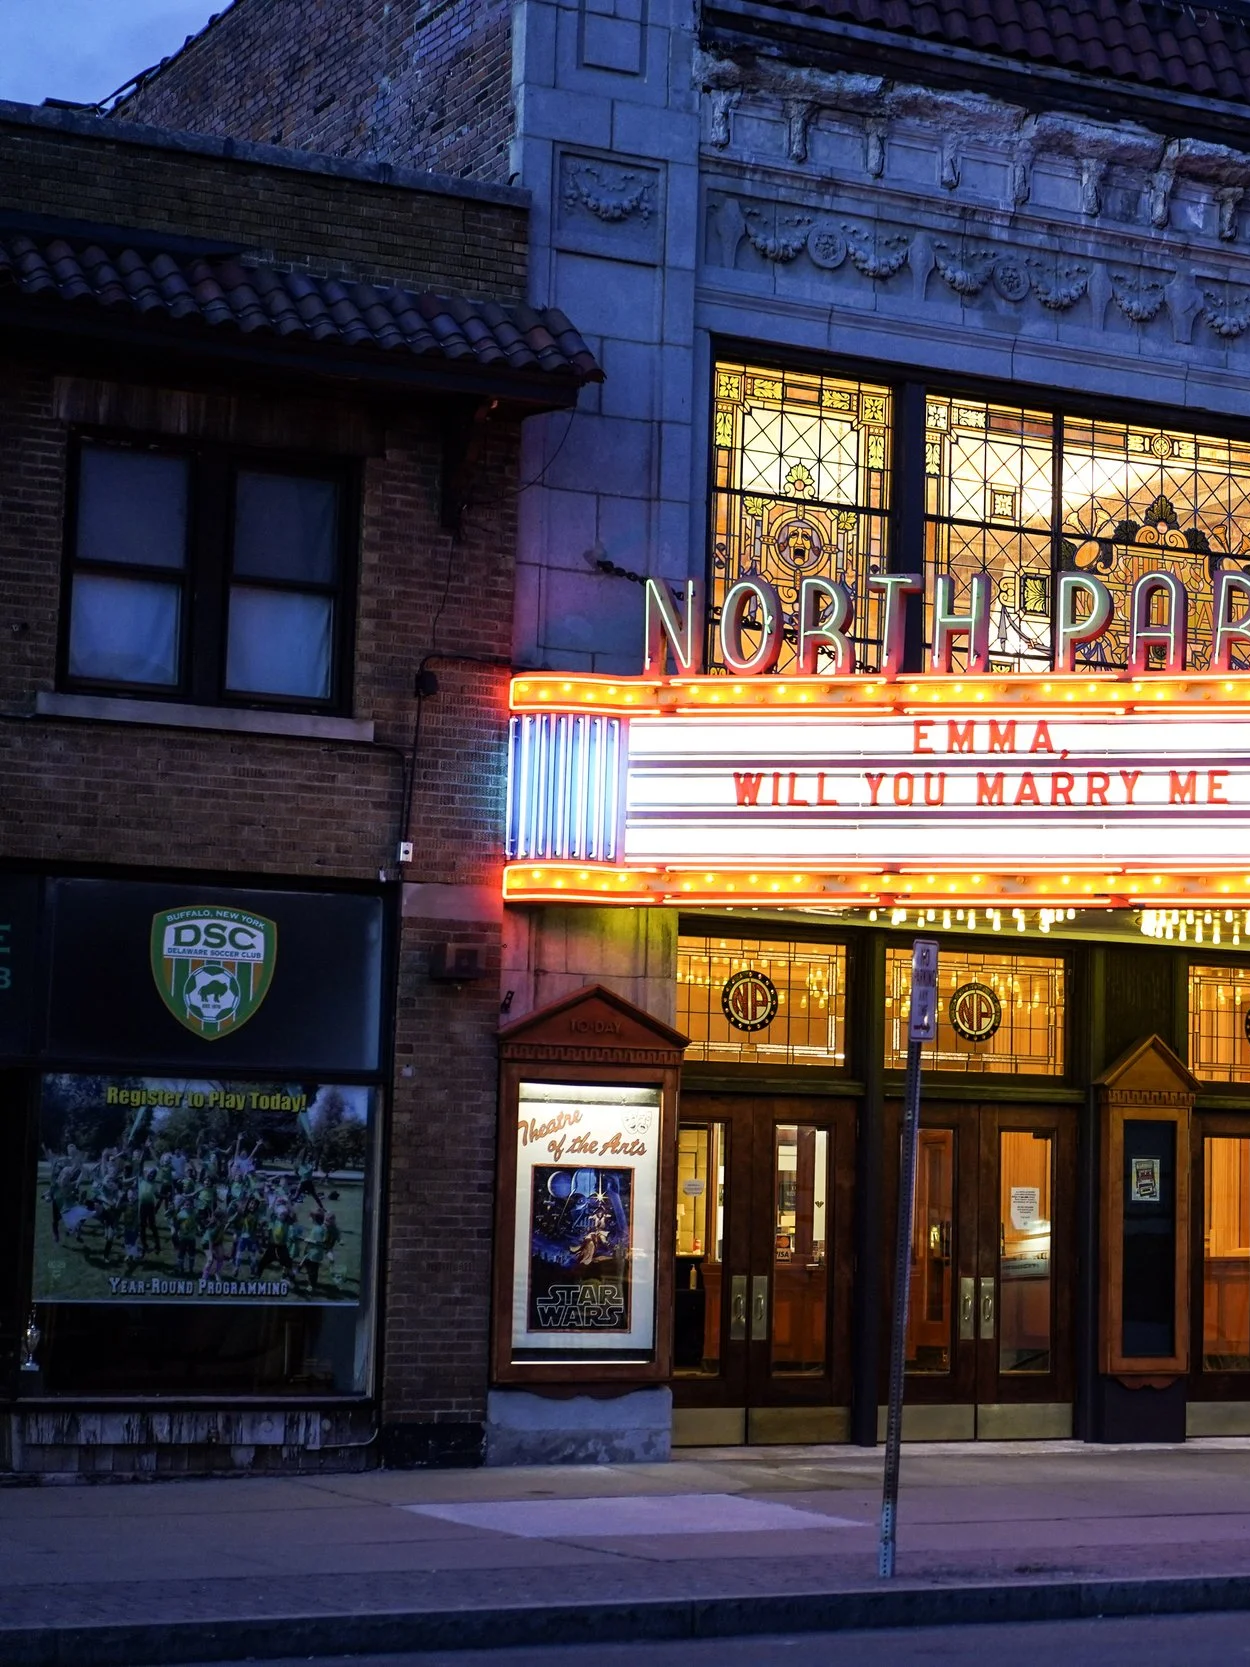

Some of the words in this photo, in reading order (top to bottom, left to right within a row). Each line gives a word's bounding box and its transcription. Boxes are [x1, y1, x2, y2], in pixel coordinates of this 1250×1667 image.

[642, 571, 993, 676] NORTH
[911, 719, 1070, 761] EMMA,
[733, 771, 839, 807] WILL
[865, 772, 947, 807] YOU
[976, 770, 1142, 806] MARRY
[1168, 769, 1230, 805] ME
[216, 910, 239, 919] NEW
[241, 914, 266, 930] YORK
[173, 923, 257, 950] DSC
[167, 947, 208, 956] DELAWARE
[210, 949, 240, 958] SOCCER
[241, 951, 261, 959] CLUB
[106, 1086, 183, 1108] Register
[187, 1091, 204, 1107] to
[208, 1090, 246, 1111] Play
[249, 1092, 308, 1113] Today!
[518, 1110, 583, 1146] Theatre
[548, 1134, 566, 1162] of
[565, 1132, 598, 1154] the
[598, 1132, 647, 1156] Arts
[776, 1250, 789, 1258] ISA
[109, 1276, 193, 1295] YEAR-ROUND
[198, 1278, 289, 1297] PROGRAMMING
[536, 1284, 623, 1306] STAR
[536, 1305, 623, 1327] WARS
